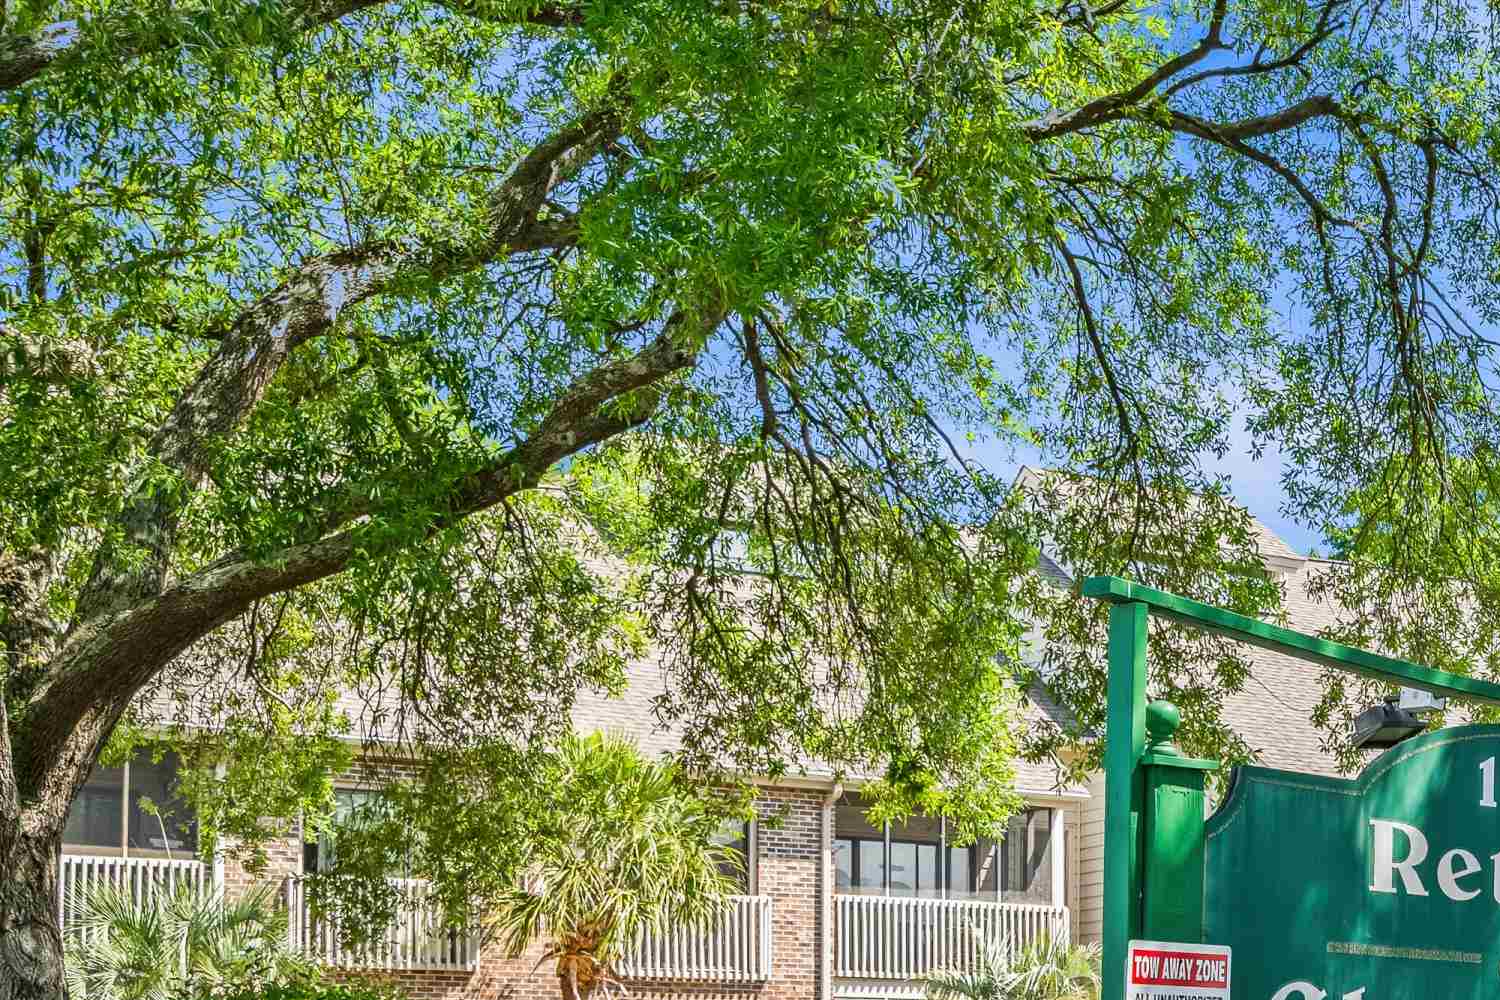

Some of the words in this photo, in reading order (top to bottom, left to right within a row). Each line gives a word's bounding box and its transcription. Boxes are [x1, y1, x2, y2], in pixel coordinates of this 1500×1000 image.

[1135, 955, 1160, 978] TOW
[1162, 957, 1193, 981] AWAY
[1195, 959, 1225, 983] ZONE
